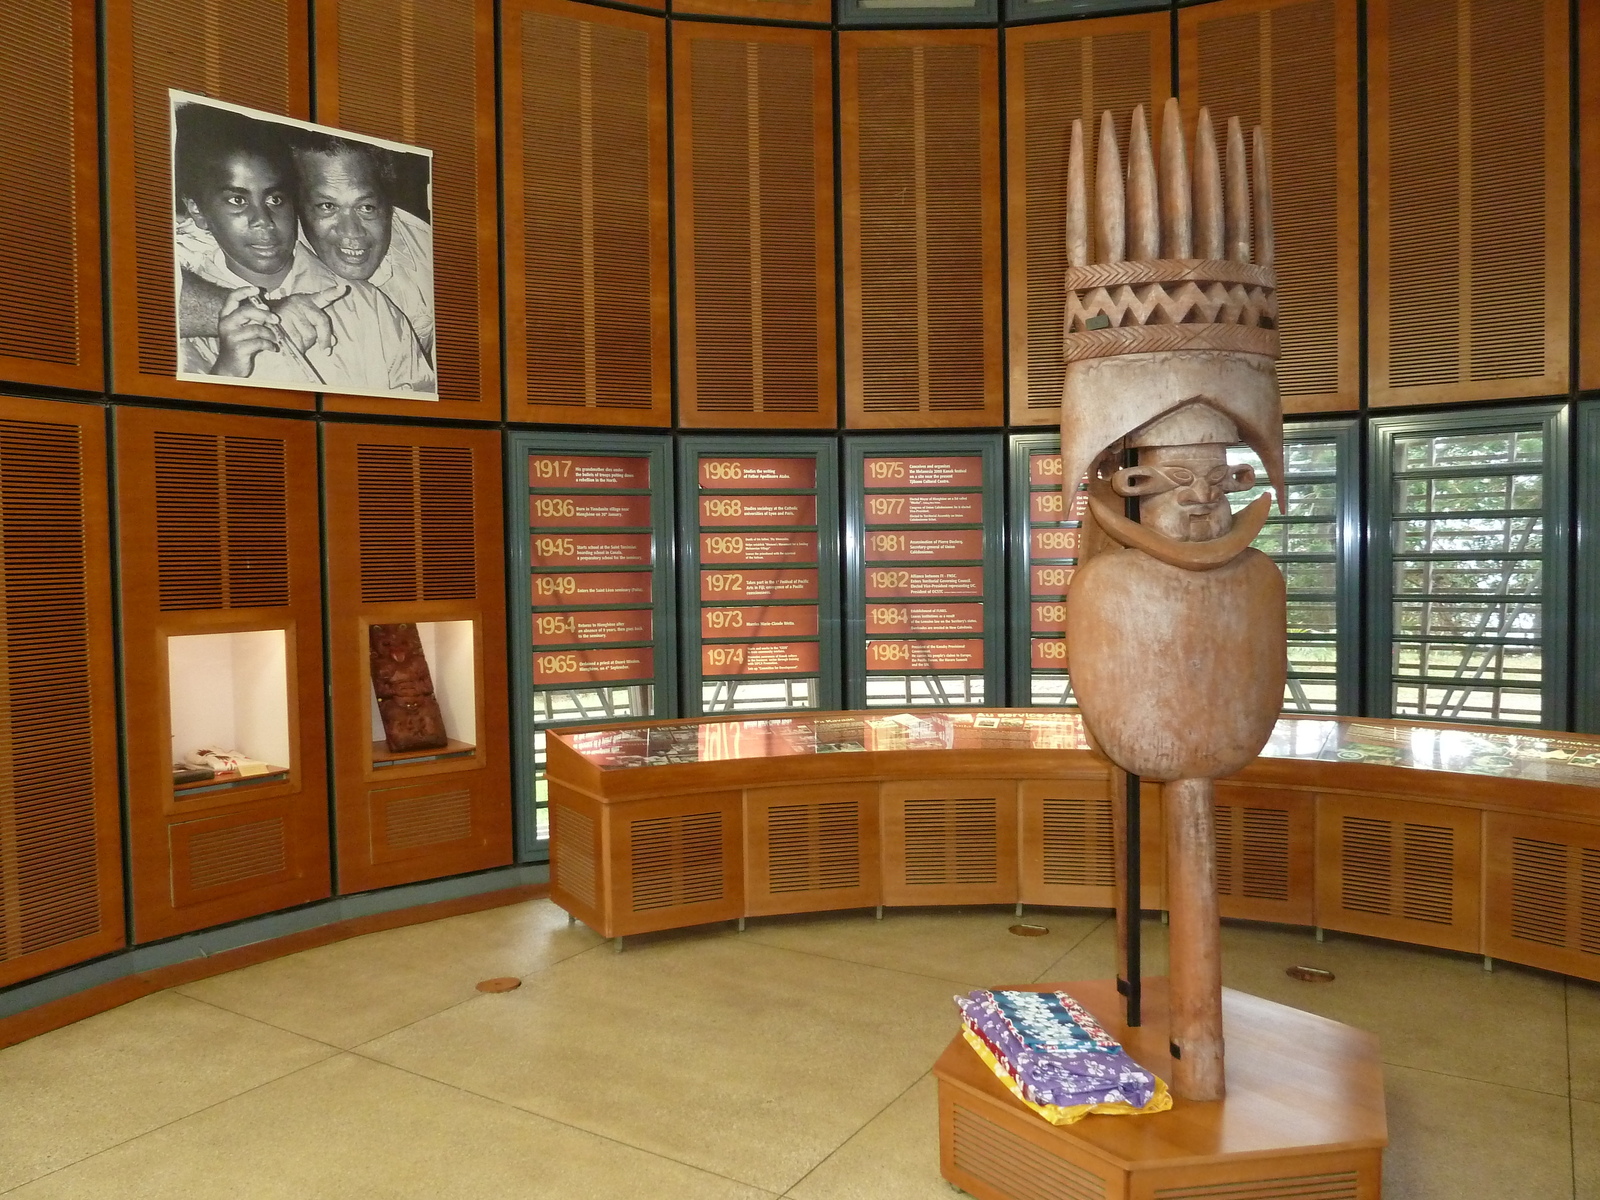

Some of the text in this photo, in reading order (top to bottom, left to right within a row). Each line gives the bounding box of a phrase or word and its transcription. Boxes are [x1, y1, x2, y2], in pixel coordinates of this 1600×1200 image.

[534, 460, 572, 478] 1917
[703, 462, 742, 479] 1966
[870, 462, 904, 478] 1975
[1036, 458, 1062, 476] 198
[535, 499, 574, 517] 1936
[704, 500, 742, 516] 1968
[870, 498, 904, 515] 1977
[1036, 496, 1062, 512] 198
[535, 538, 574, 556] 1945
[705, 536, 744, 554] 1969
[870, 534, 905, 552] 1981
[1036, 532, 1075, 549] 1986
[536, 576, 575, 595] 1949
[706, 574, 742, 591] 1972
[870, 571, 909, 588] 1982
[1036, 570, 1074, 586] 1987
[706, 610, 742, 628] 1973
[871, 608, 908, 624] 1984
[536, 616, 575, 634] 1954
[707, 648, 744, 666] 1974
[872, 644, 910, 660] 1984
[1038, 642, 1066, 658] 198
[537, 655, 576, 674] 1965
